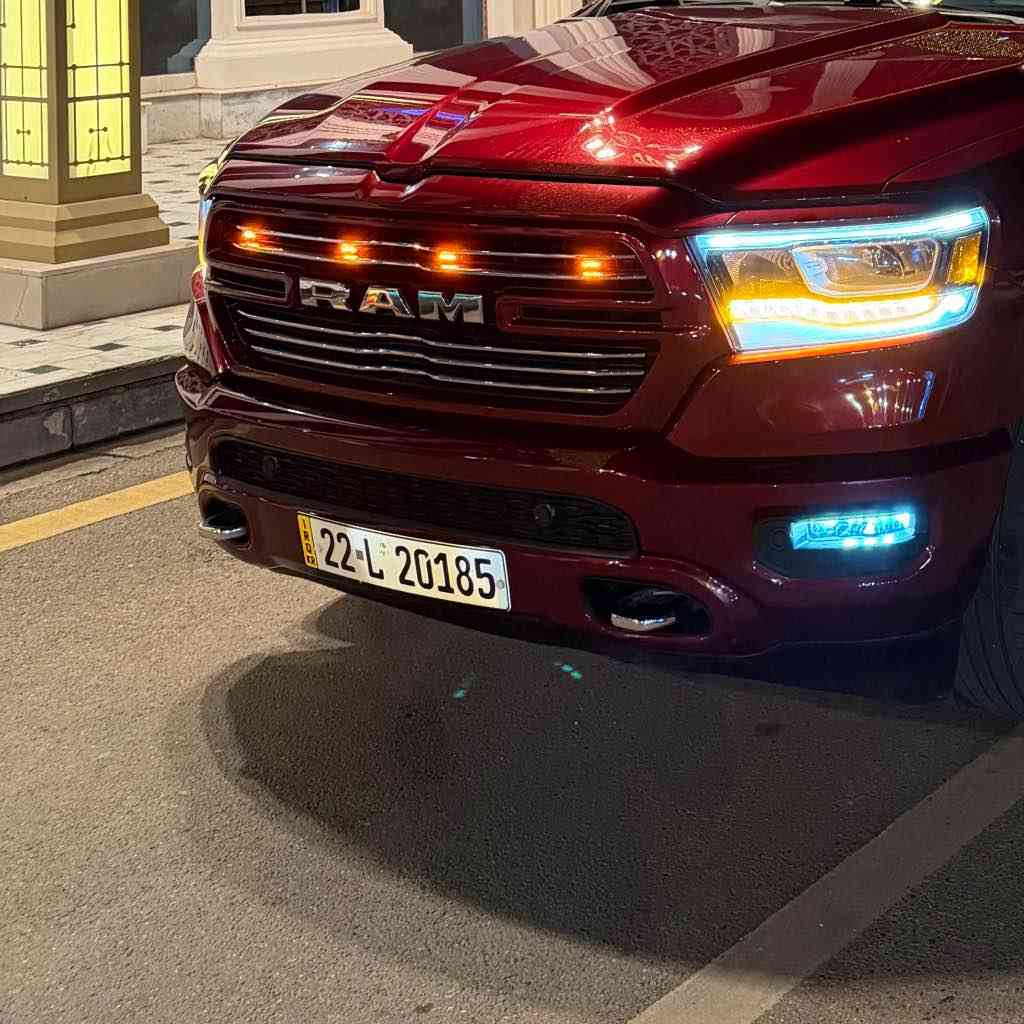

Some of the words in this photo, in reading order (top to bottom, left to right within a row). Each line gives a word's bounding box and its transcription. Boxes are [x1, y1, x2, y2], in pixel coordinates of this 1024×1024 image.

[300, 277, 484, 324] RAM
[320, 528, 356, 573] 22
[364, 538, 384, 580] L
[395, 545, 496, 599] 20185
